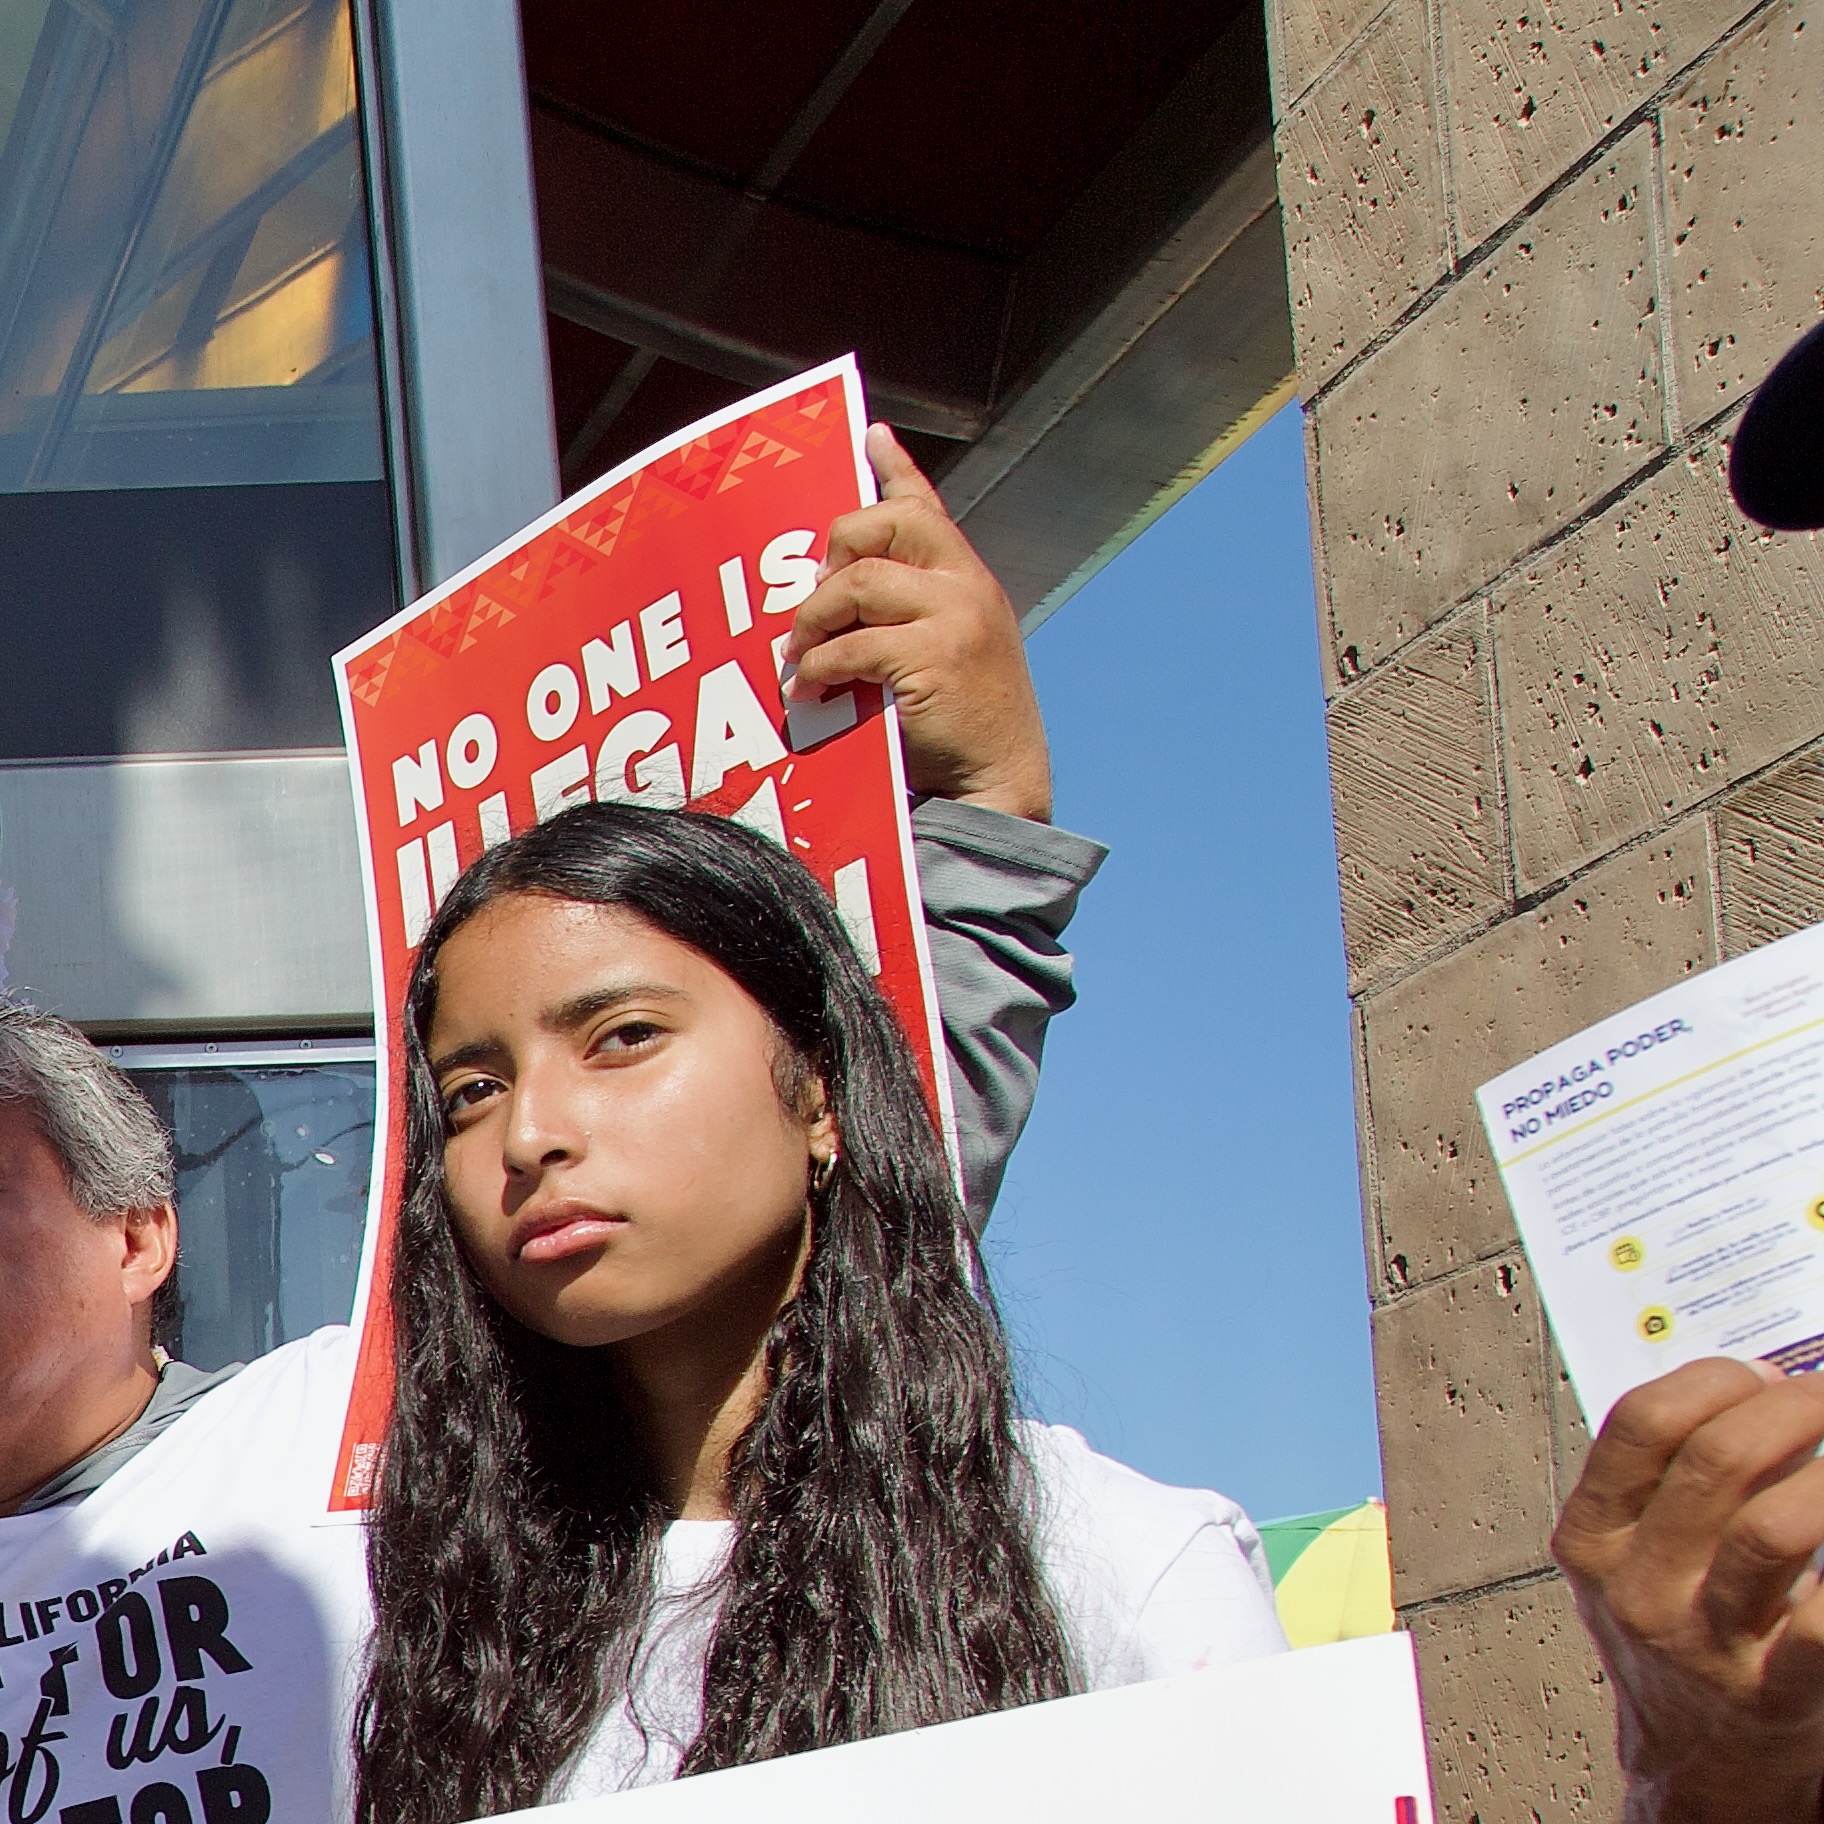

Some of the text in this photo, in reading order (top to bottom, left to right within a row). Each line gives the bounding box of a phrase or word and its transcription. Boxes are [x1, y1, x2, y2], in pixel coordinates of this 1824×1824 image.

[391, 529, 817, 826] NO ONE IS
[1502, 1018, 1693, 1119] PROPAGA PODER,
[1509, 1081, 1614, 1143] NO MIEDO
[105, 1686, 241, 1771] us,
